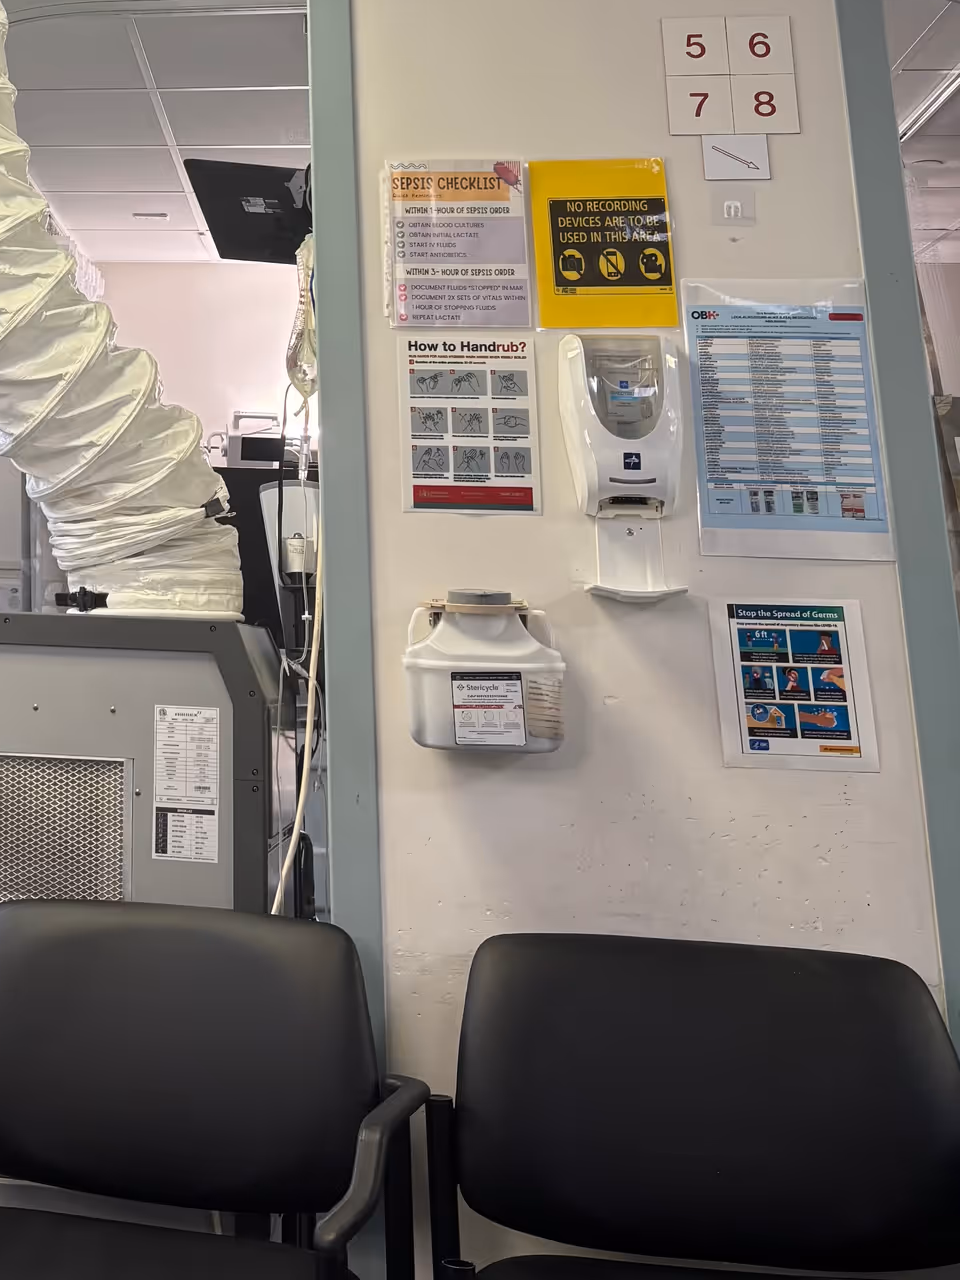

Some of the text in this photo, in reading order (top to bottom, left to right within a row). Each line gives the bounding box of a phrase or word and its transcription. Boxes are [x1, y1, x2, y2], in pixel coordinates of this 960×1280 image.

[685, 32, 771, 59] 5 6
[689, 91, 777, 118] 7 8
[392, 176, 502, 190] SEPSIS CHECKLIST
[404, 206, 429, 214] WITHIN
[466, 206, 488, 214] SEPSIS
[489, 206, 510, 214] ORDER
[566, 200, 648, 212] NO RECORDING
[558, 215, 660, 228] DEVICES ARE TO BE
[560, 231, 661, 243] USED IN THIS AREA
[406, 268, 429, 276] WITHIN
[441, 268, 460, 276] HOUR
[471, 268, 492, 277] SEPSIS
[494, 268, 515, 276] ORDER
[408, 340, 527, 352] How to Handrub?
[738, 609, 757, 618] Stop
[758, 609, 771, 617] the
[772, 610, 801, 619] Spread
[811, 611, 838, 619] Germs
[755, 630, 768, 638] 6 ft
